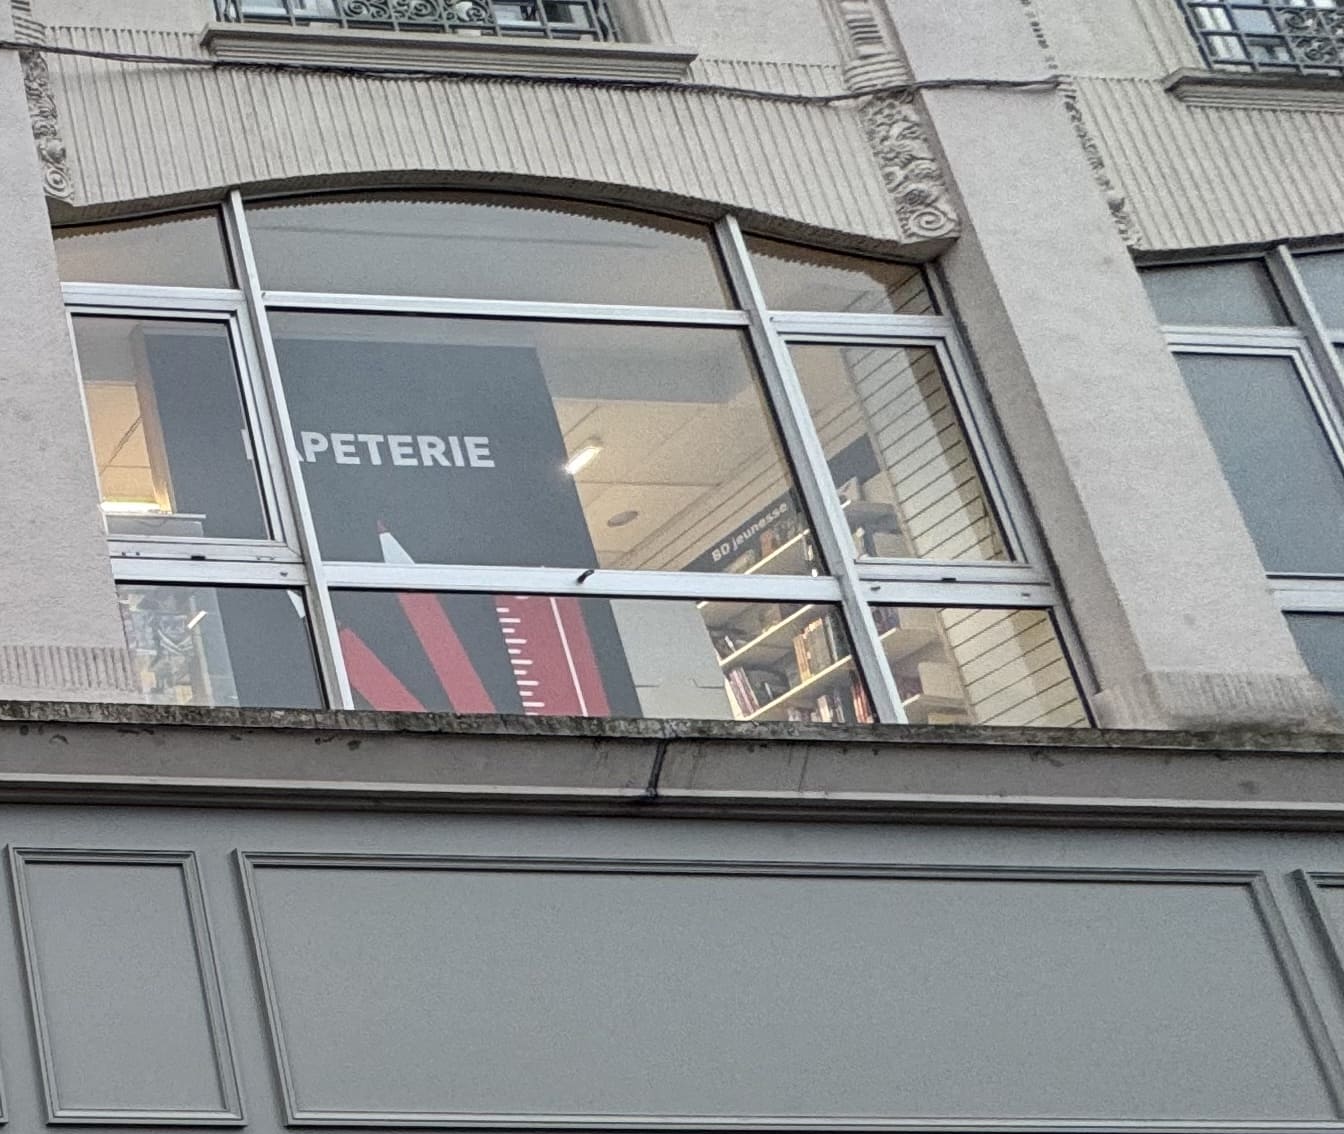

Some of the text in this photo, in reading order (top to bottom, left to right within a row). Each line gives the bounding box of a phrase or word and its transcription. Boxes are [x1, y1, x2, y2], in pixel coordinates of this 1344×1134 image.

[240, 428, 496, 468] PETERIE
[712, 502, 788, 562] BD jeunesse
